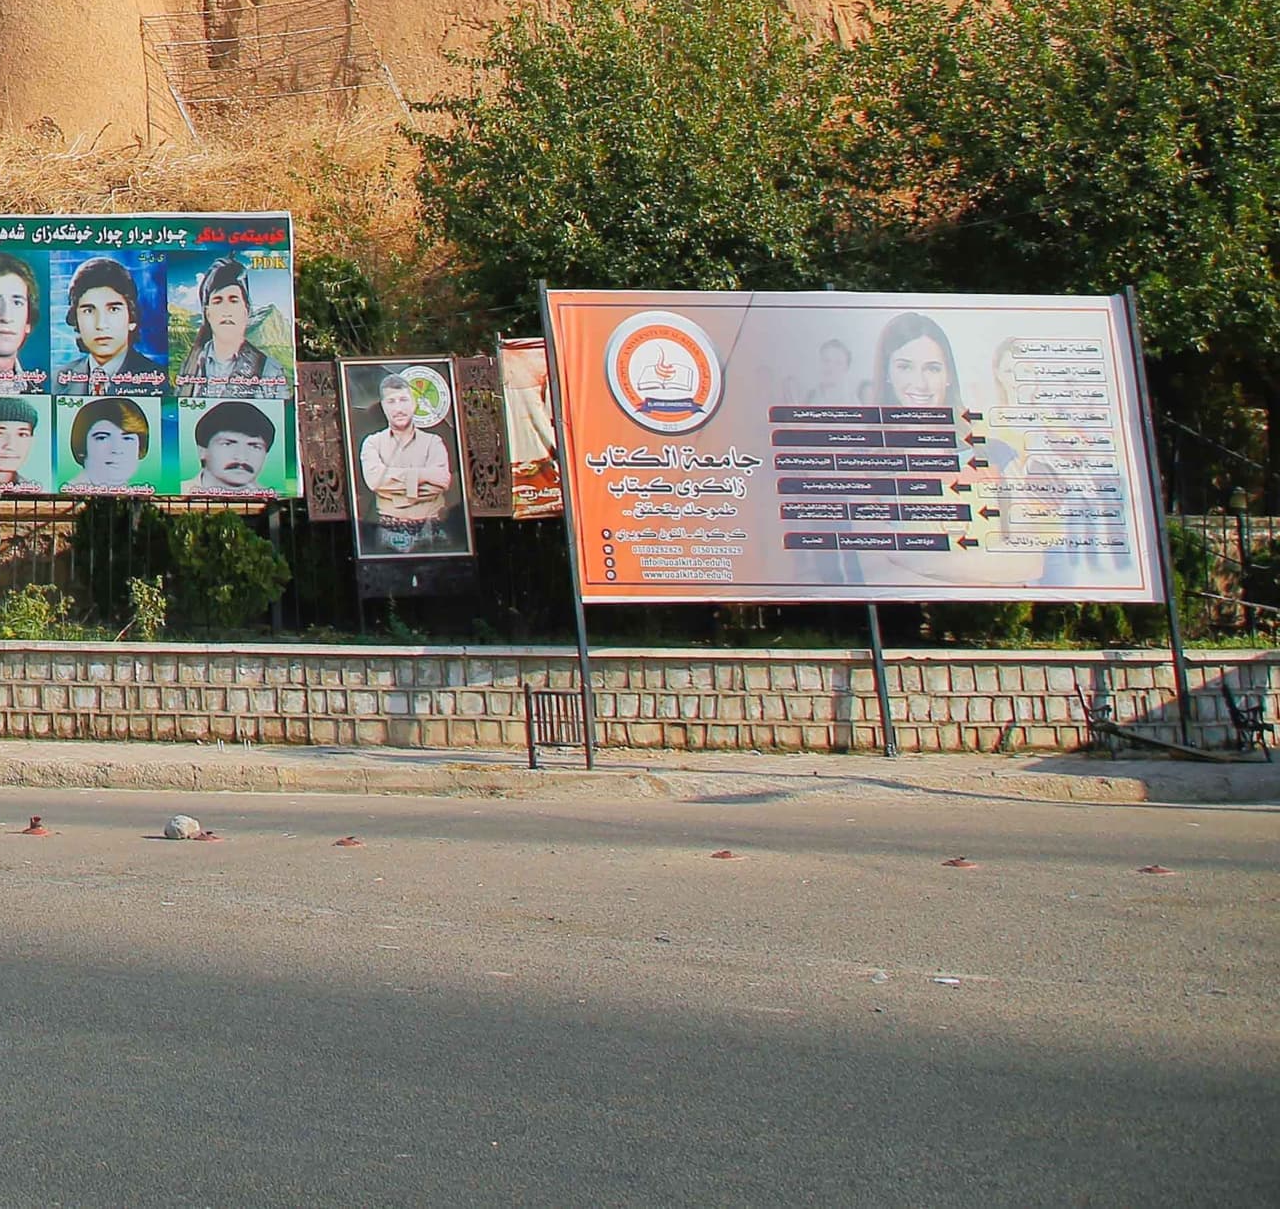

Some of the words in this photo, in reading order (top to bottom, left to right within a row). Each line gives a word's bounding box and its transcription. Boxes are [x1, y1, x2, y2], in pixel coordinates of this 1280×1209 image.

[252, 256, 288, 269] PDK
[586, 445, 679, 474] الكتاب
[682, 445, 763, 474] جامعة
[682, 503, 737, 520] طموحك
[694, 528, 748, 541] كركوك
[642, 571, 733, 581] www.uoalkitab.edu.iq
